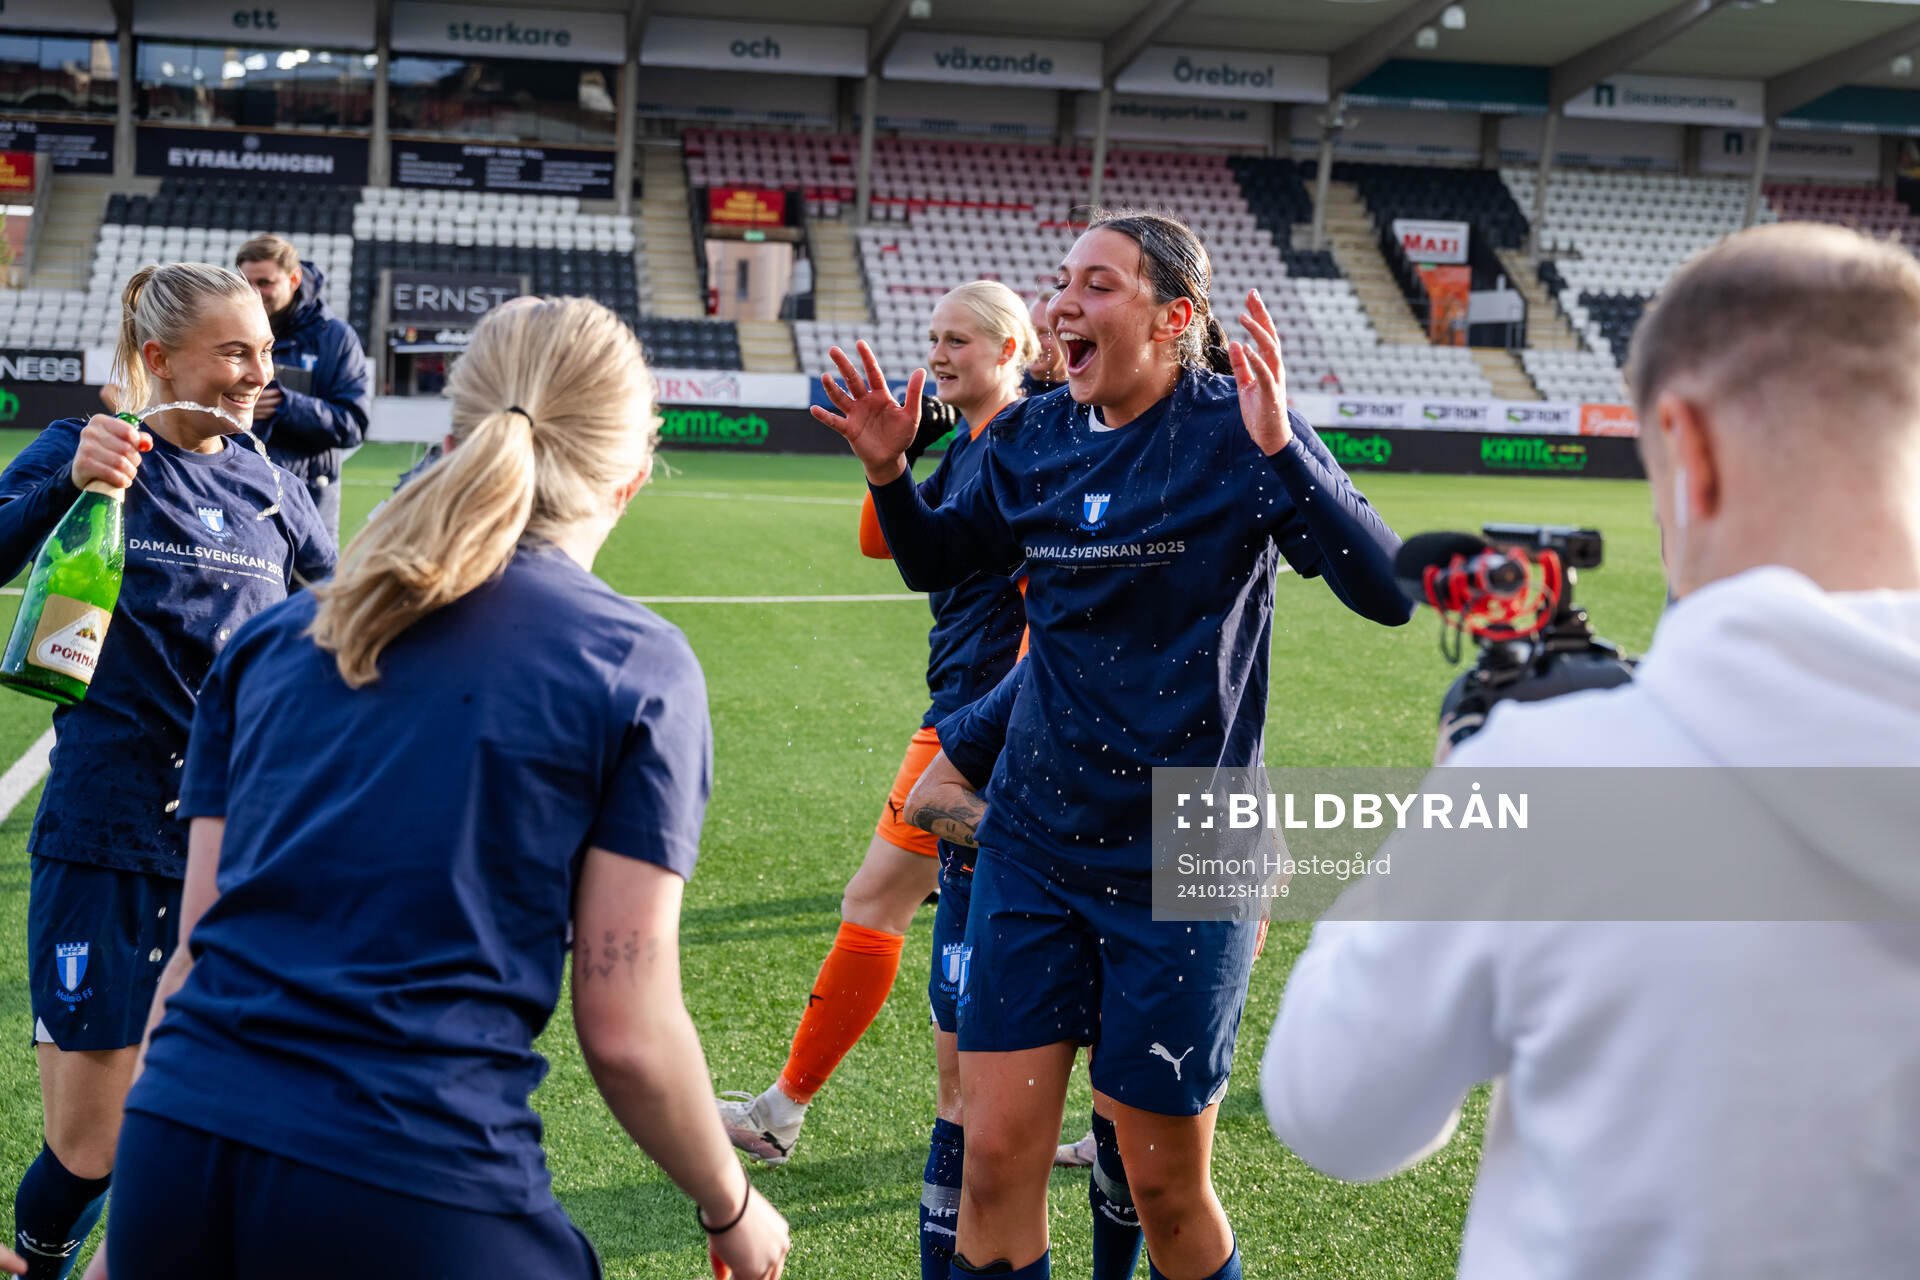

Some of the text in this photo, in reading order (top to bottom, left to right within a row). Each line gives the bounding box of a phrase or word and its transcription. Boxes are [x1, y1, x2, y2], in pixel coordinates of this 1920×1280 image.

[232, 9, 279, 30] ett
[446, 21, 572, 47] starkare
[730, 36, 781, 60] och
[933, 46, 1054, 75] växande
[1174, 56, 1275, 88] Örebro!
[394, 282, 512, 314] ERNST
[129, 538, 266, 570] DAMALLSVENSKAN
[1025, 540, 1186, 559] DAMALLSVENSKAN 2025
[928, 1207, 958, 1218] MF
